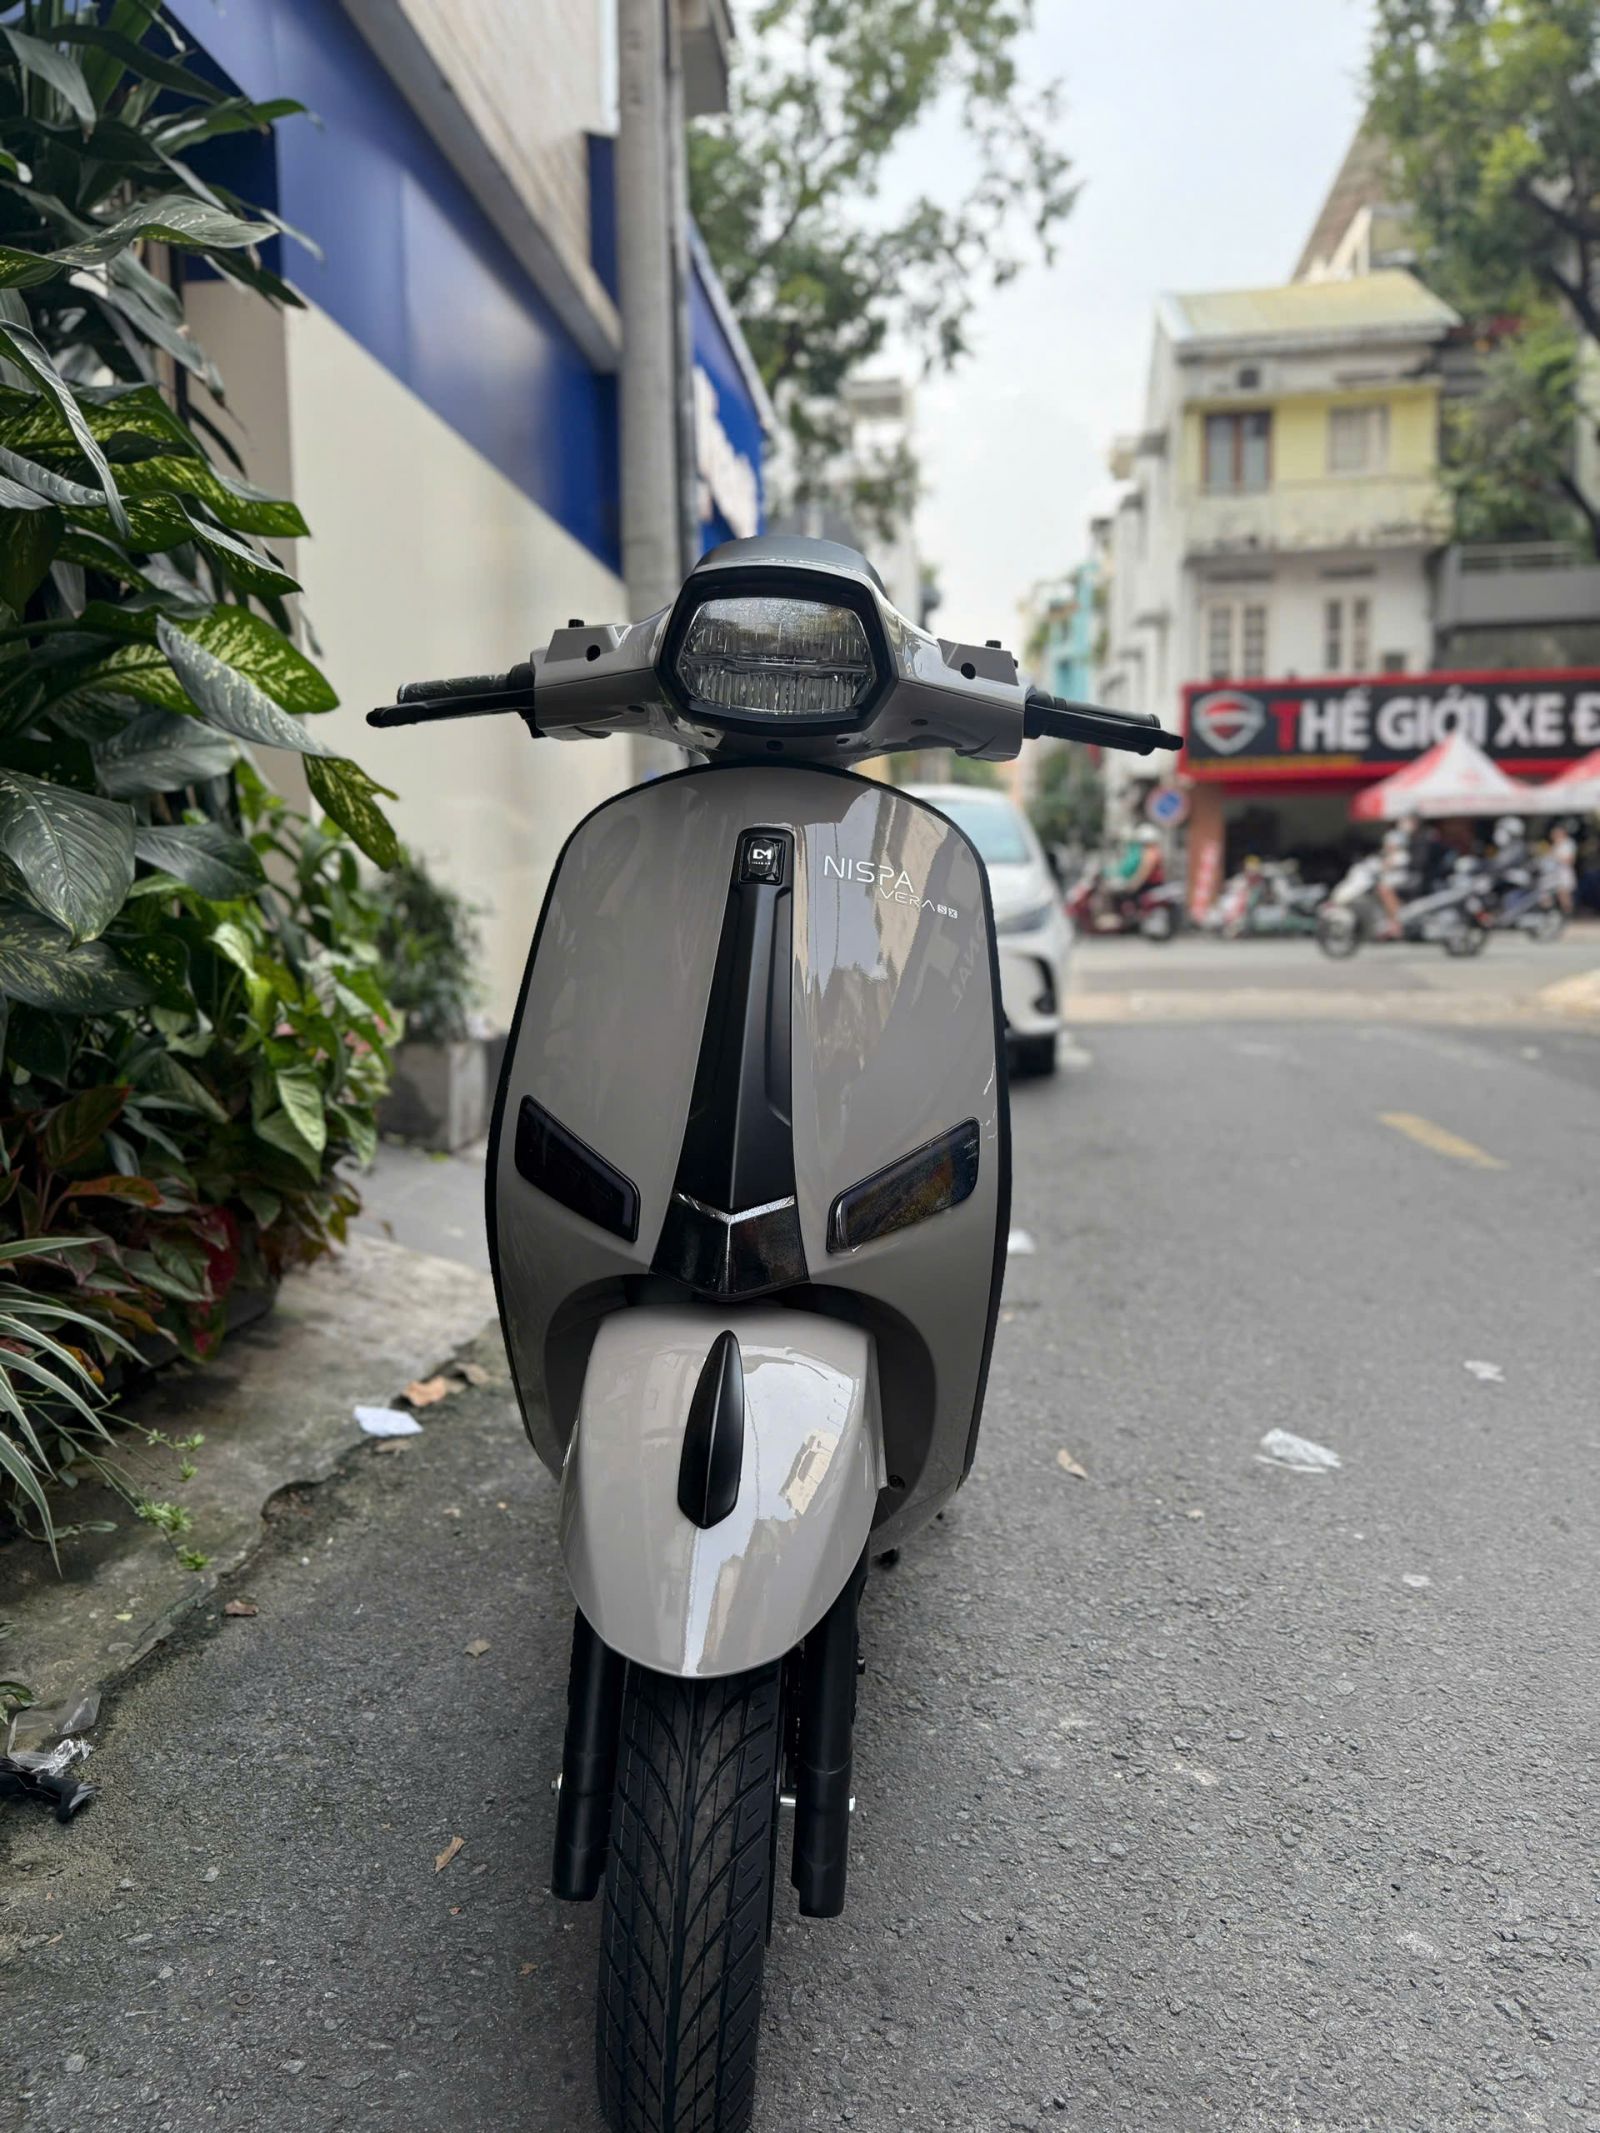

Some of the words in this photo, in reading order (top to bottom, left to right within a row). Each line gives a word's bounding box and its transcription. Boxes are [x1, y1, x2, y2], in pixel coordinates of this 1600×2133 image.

[1494, 693, 1566, 748] XE
[824, 855, 914, 893] NISPA
[879, 887, 935, 912] VERA
